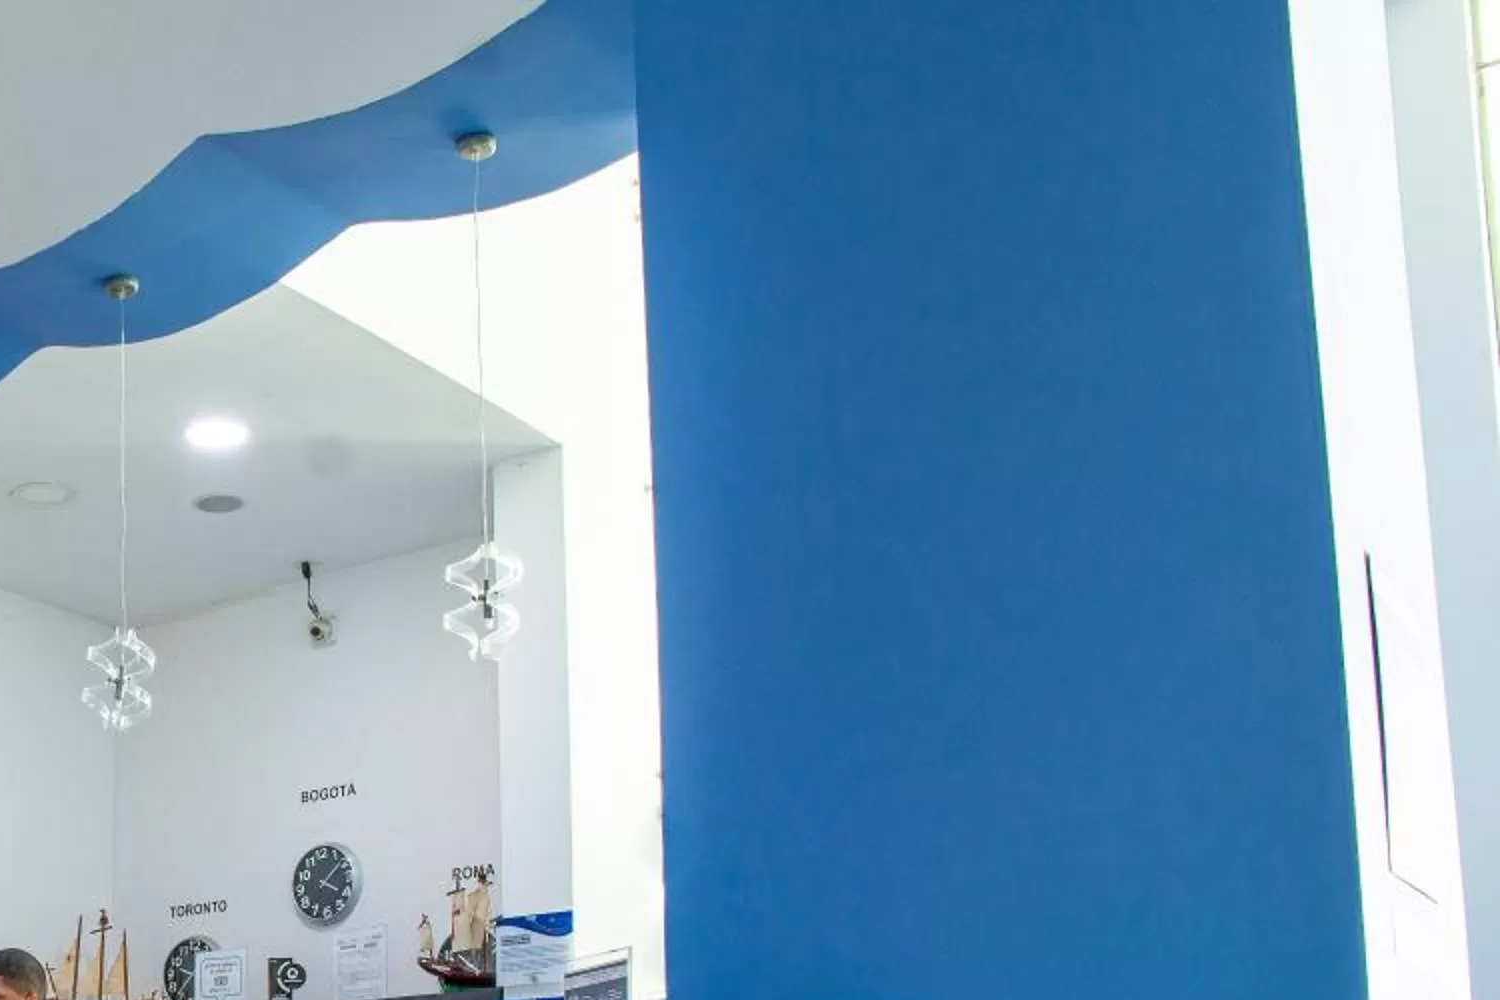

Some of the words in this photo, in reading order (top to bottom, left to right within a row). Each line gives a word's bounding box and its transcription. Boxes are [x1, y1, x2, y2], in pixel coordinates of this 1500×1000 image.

[315, 847, 328, 860] 12
[299, 869, 311, 882] 10
[170, 899, 228, 918] TORONTO
[301, 896, 310, 909] 8
